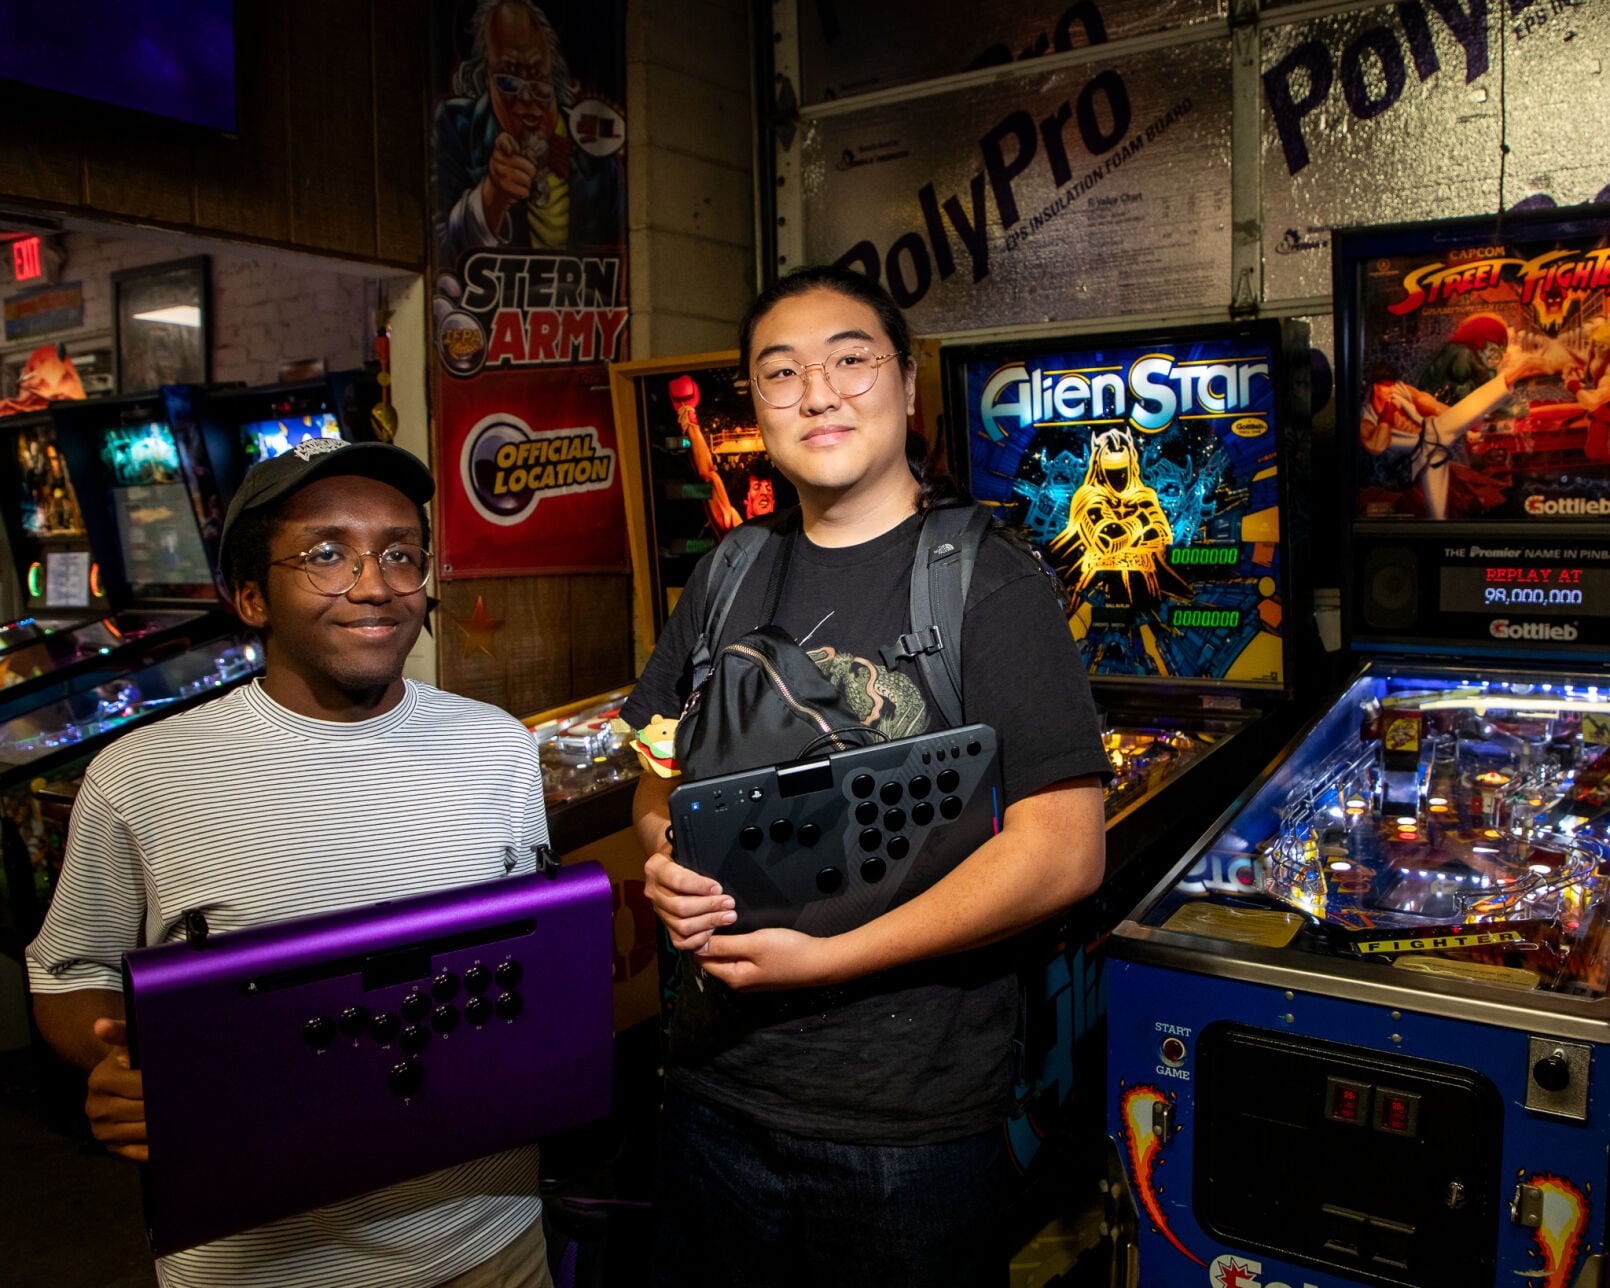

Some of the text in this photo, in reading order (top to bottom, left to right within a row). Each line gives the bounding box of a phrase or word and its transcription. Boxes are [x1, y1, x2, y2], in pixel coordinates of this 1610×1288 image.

[1029, 165, 1104, 234] INSULATION
[1105, 134, 1145, 174] FOAM
[1145, 97, 1194, 143] BOARD
[13, 236, 42, 282] EXIT
[1449, 245, 1506, 261] CAPCOM
[461, 253, 621, 313] STERN
[1387, 256, 1527, 317] STREET
[486, 307, 629, 366] ARMY
[980, 361, 1126, 441] Alien
[496, 435, 595, 469] OFFICIAL
[493, 457, 610, 495] LOCATION
[1171, 547, 1239, 565] 0000000
[1444, 547, 1466, 558] THE
[1468, 545, 1522, 559] Premier
[1524, 548, 1562, 559] NAME
[1563, 549, 1578, 559] IN
[1485, 567, 1584, 585] REPLAY AT
[1484, 587, 1584, 607] 98,000,000
[1173, 610, 1240, 627] 0000000
[1489, 618, 1579, 642] Gottlieb
[1367, 932, 1516, 952] FIGHTER
[1155, 1021, 1192, 1038] START
[1155, 1065, 1191, 1081] GAME
